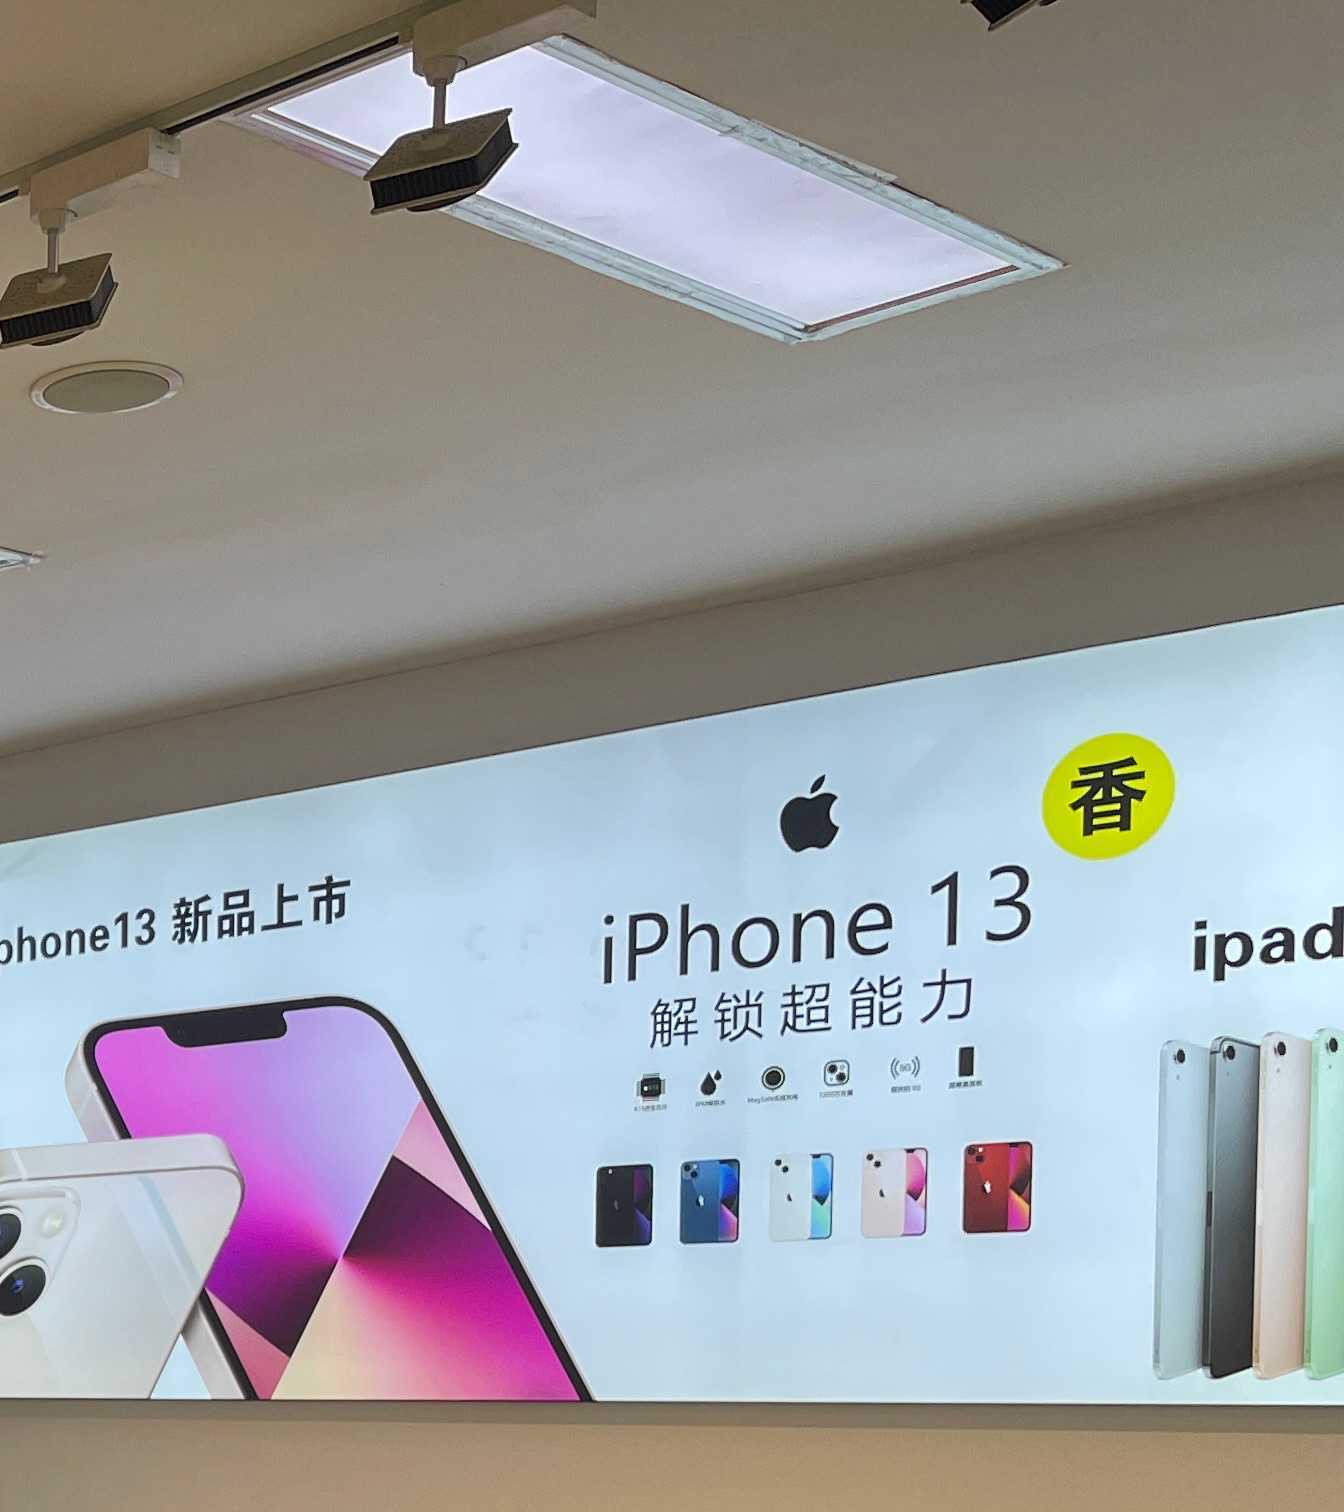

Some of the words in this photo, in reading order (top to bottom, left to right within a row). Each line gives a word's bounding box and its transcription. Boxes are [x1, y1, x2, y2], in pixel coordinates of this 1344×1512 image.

[1069, 756, 1147, 837] 香
[171, 875, 352, 945] 新品上市
[602, 900, 894, 985] iPhone
[929, 864, 1032, 947] 13
[1193, 905, 1344, 983] ipad
[649, 968, 974, 1049] 解锁超能力
